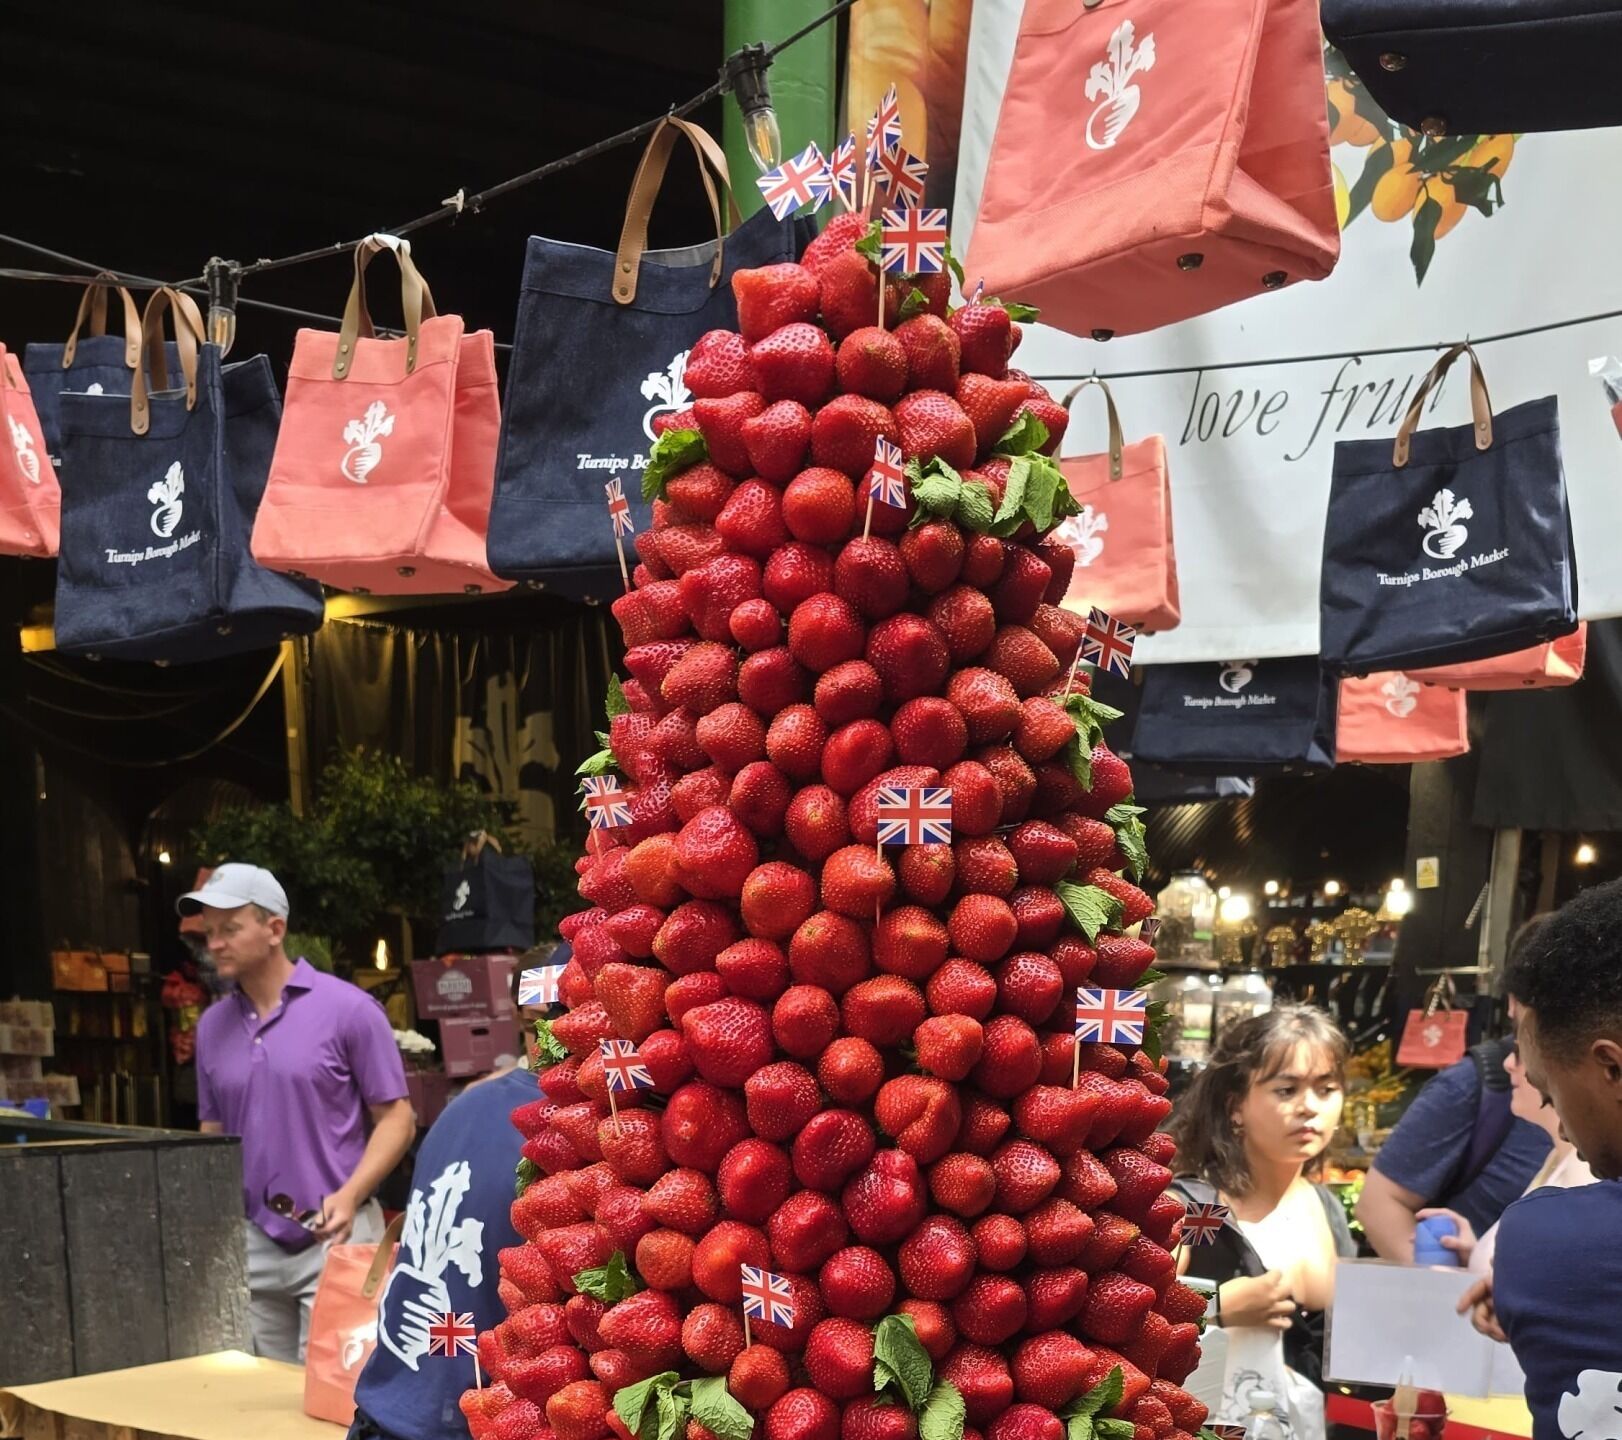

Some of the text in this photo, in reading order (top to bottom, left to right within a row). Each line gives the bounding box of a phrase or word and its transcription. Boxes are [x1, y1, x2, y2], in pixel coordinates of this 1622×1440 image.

[1179, 367, 1289, 446] love
[577, 453, 629, 474] Turnips
[104, 548, 145, 567] Turnips
[1376, 547, 1509, 588] Turnips Borough Market
